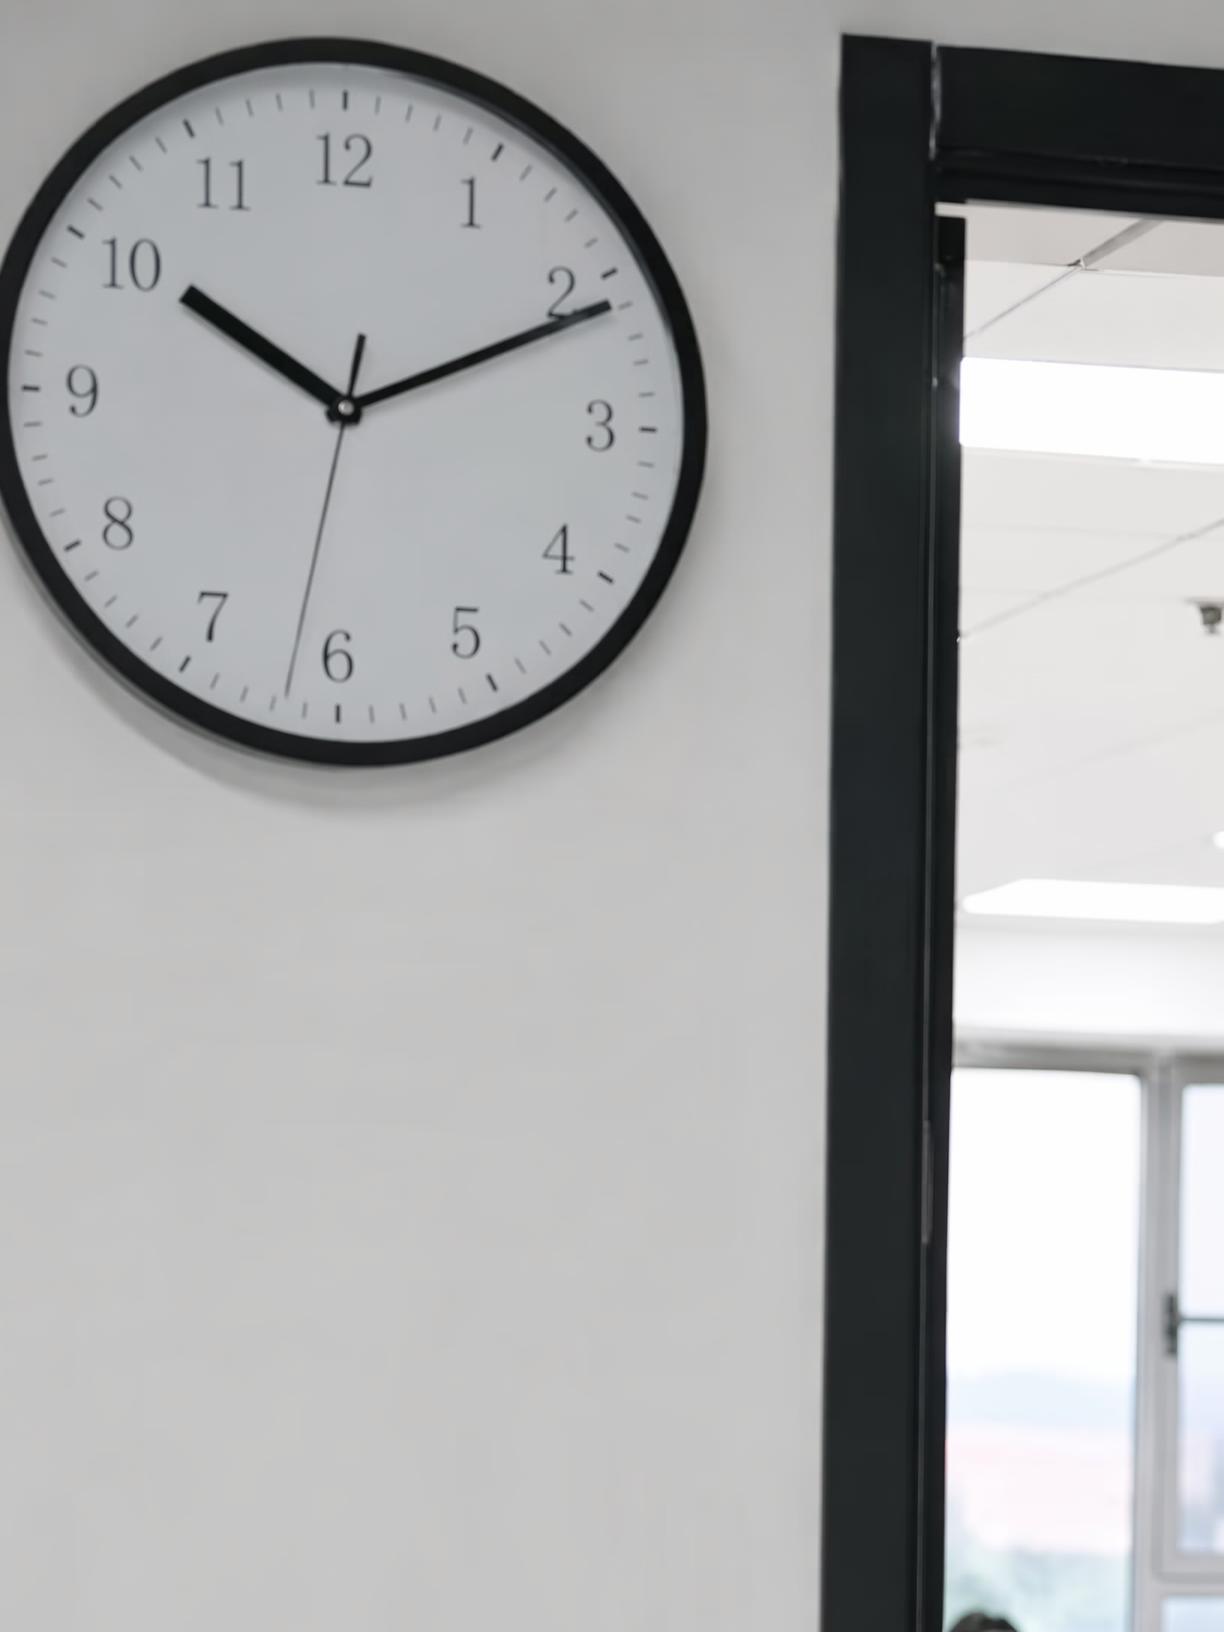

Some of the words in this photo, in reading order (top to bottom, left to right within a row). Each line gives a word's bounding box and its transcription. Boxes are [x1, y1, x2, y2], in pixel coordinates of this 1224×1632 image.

[198, 157, 250, 211] 11
[317, 132, 373, 188] 12
[461, 176, 481, 229] 1
[102, 237, 162, 292] 10
[546, 267, 577, 320] 2
[66, 365, 99, 417] 9
[586, 400, 615, 452] 3
[102, 497, 134, 550] 8
[542, 523, 574, 575] 4
[198, 591, 229, 643] 7
[451, 606, 481, 659] 5
[322, 630, 354, 683] 6
